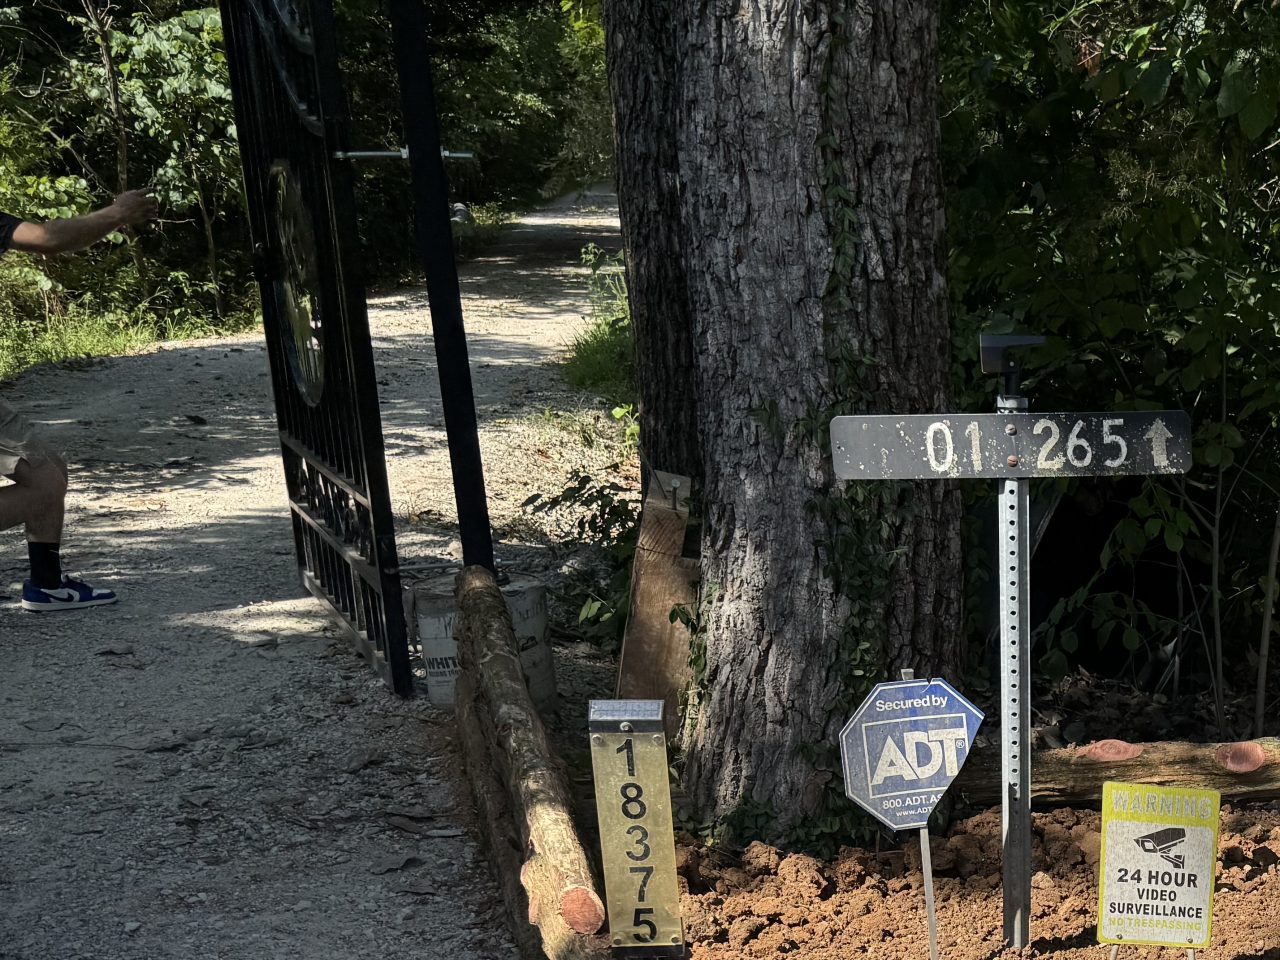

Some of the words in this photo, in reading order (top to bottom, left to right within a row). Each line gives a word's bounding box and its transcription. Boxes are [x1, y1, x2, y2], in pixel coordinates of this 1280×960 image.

[925, 421, 982, 471] 01
[1032, 418, 1128, 470] 265
[426, 656, 459, 670] WHIT
[876, 695, 930, 712] Secured
[931, 694, 948, 709] by
[1112, 790, 1212, 819] WARNING
[616, 738, 658, 943] 18375
[1117, 868, 1143, 884] 24
[1147, 870, 1198, 888] HOUR
[1137, 888, 1177, 902] VIDEO
[1109, 902, 1203, 919] SURVEILLANCE
[1108, 917, 1124, 927] NO
[1127, 918, 1203, 931] TRESPASSING
